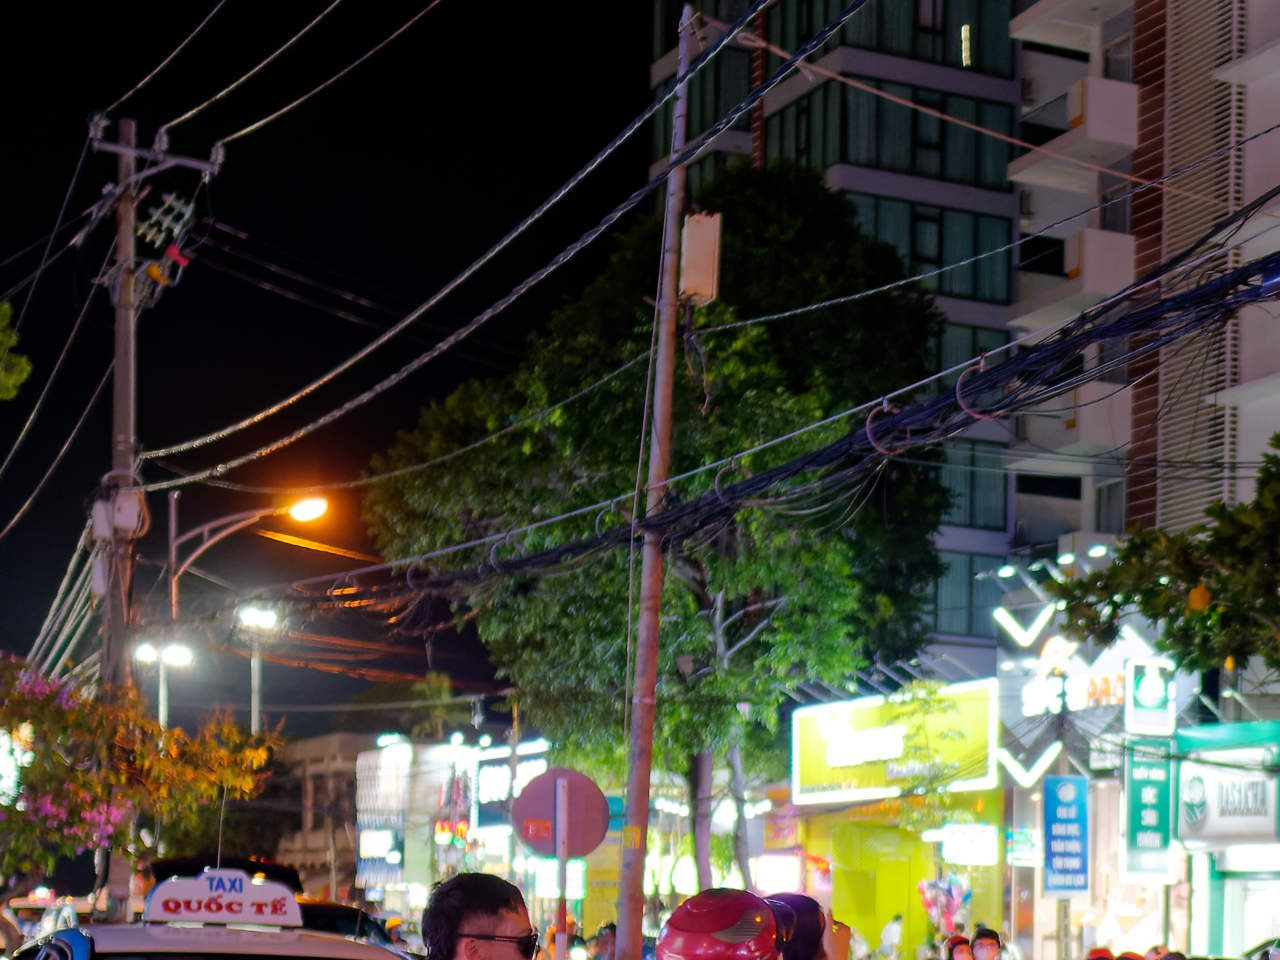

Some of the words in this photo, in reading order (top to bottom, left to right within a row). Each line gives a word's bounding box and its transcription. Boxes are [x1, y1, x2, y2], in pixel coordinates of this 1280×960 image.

[206, 876, 244, 893] TAXI
[161, 894, 243, 915] QUỐC
[251, 897, 288, 915] TẾ
